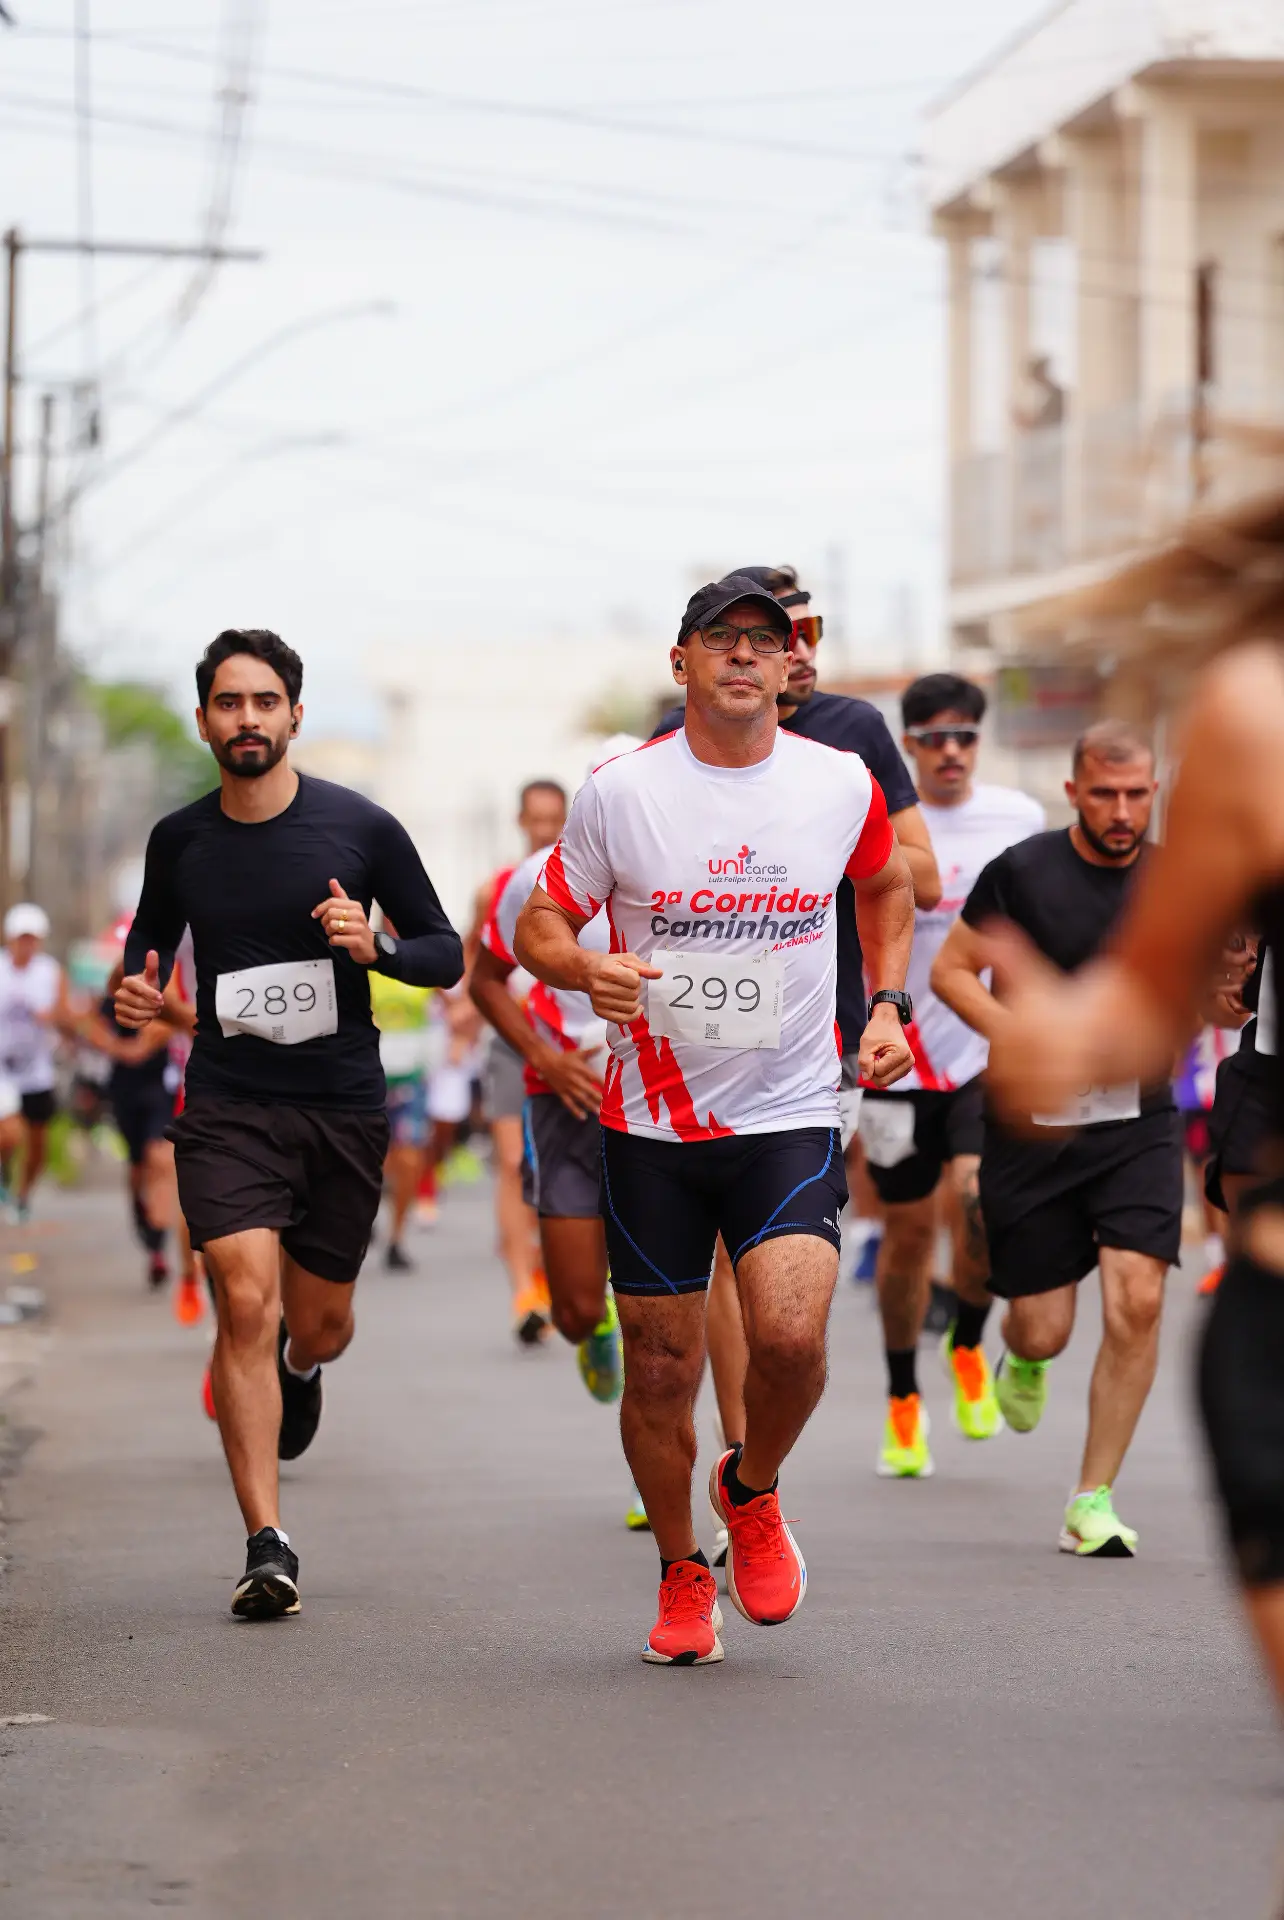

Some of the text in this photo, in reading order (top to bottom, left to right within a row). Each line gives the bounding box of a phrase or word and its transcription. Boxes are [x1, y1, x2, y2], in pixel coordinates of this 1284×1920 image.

[724, 876, 746, 885] Felipe
[690, 885, 819, 914] Corrida
[236, 982, 316, 1019] 289
[668, 974, 761, 1013] 299
